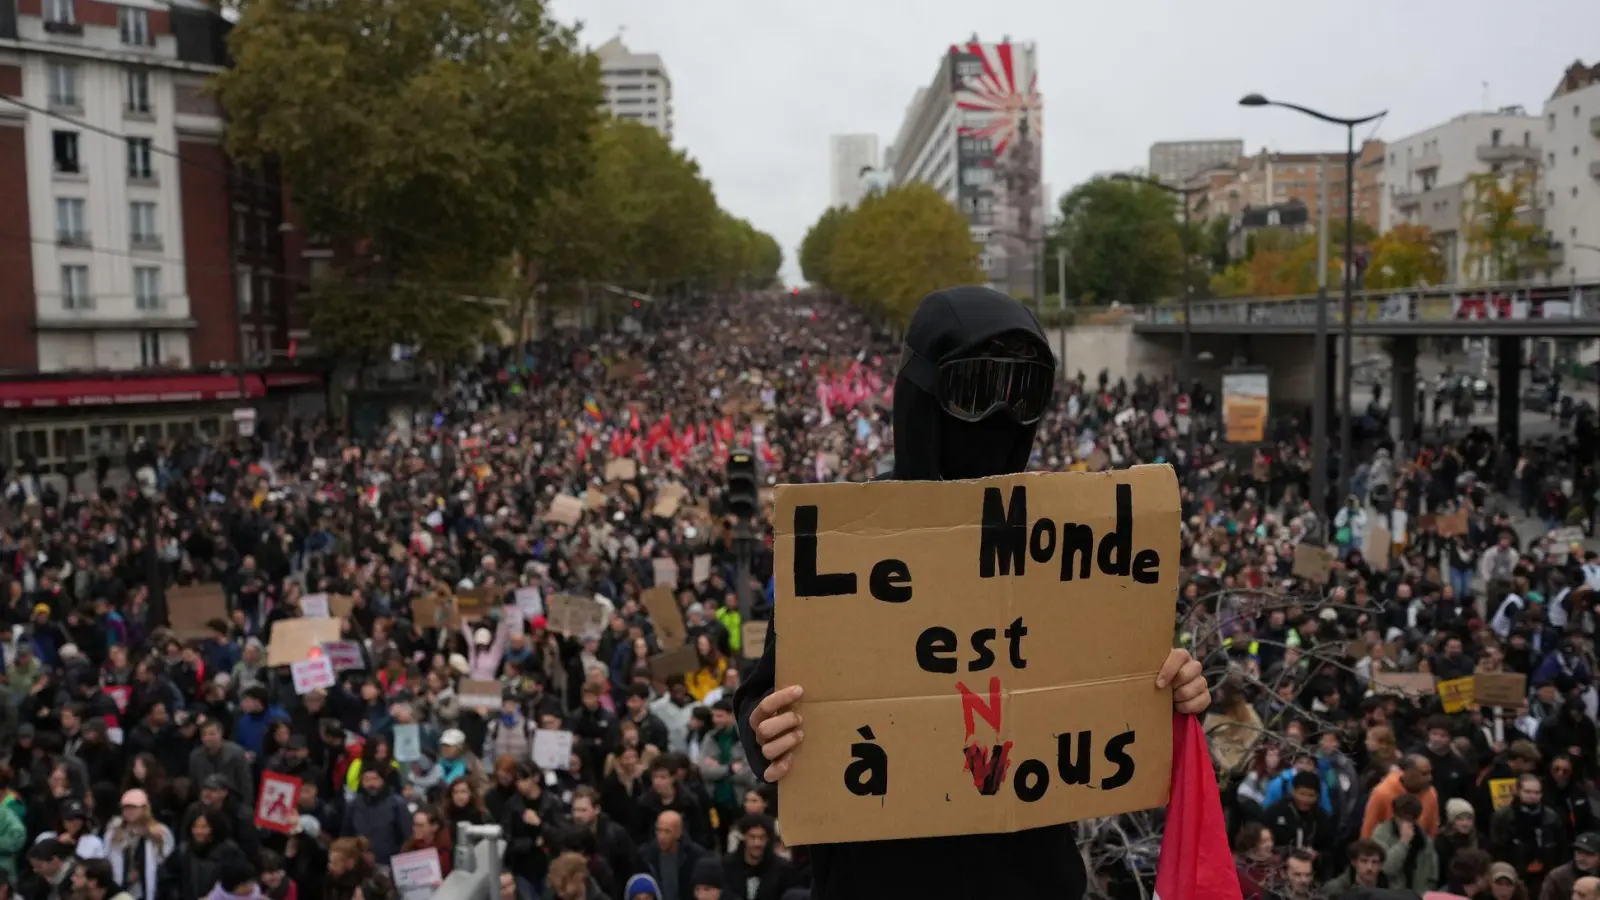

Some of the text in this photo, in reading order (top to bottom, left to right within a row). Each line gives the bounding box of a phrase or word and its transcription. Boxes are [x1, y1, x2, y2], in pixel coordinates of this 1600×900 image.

[793, 484, 1160, 603] Le Monde
[915, 617, 1028, 674] est
[843, 725, 888, 797] à
